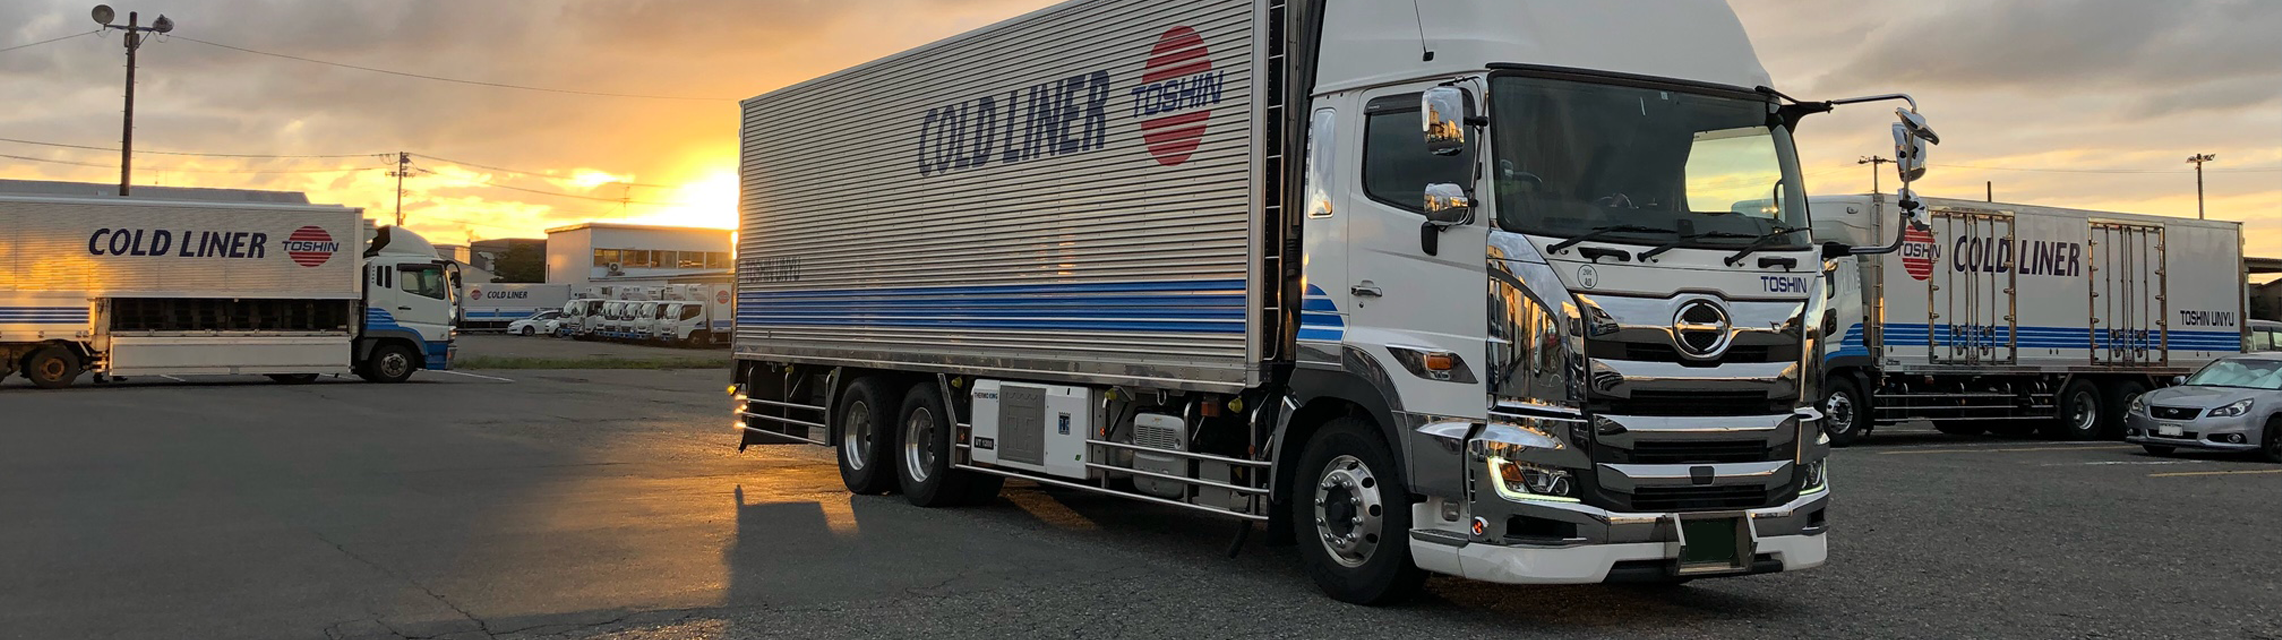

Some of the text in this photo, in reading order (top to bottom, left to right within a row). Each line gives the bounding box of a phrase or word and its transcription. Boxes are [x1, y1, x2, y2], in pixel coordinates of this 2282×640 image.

[1131, 70, 1224, 118] TOSHIN
[918, 69, 1110, 177] COLD LINER
[88, 228, 267, 258] COLD LINER
[282, 240, 339, 252] TOSHIN
[1897, 242, 1941, 258] TOSHN
[1953, 235, 2080, 277] COLD LINER
[1760, 276, 1807, 293] TOSHIN
[487, 291, 506, 299] COLD
[507, 291, 528, 299] LINER
[2180, 310, 2234, 327] TOSHIN UNYU
